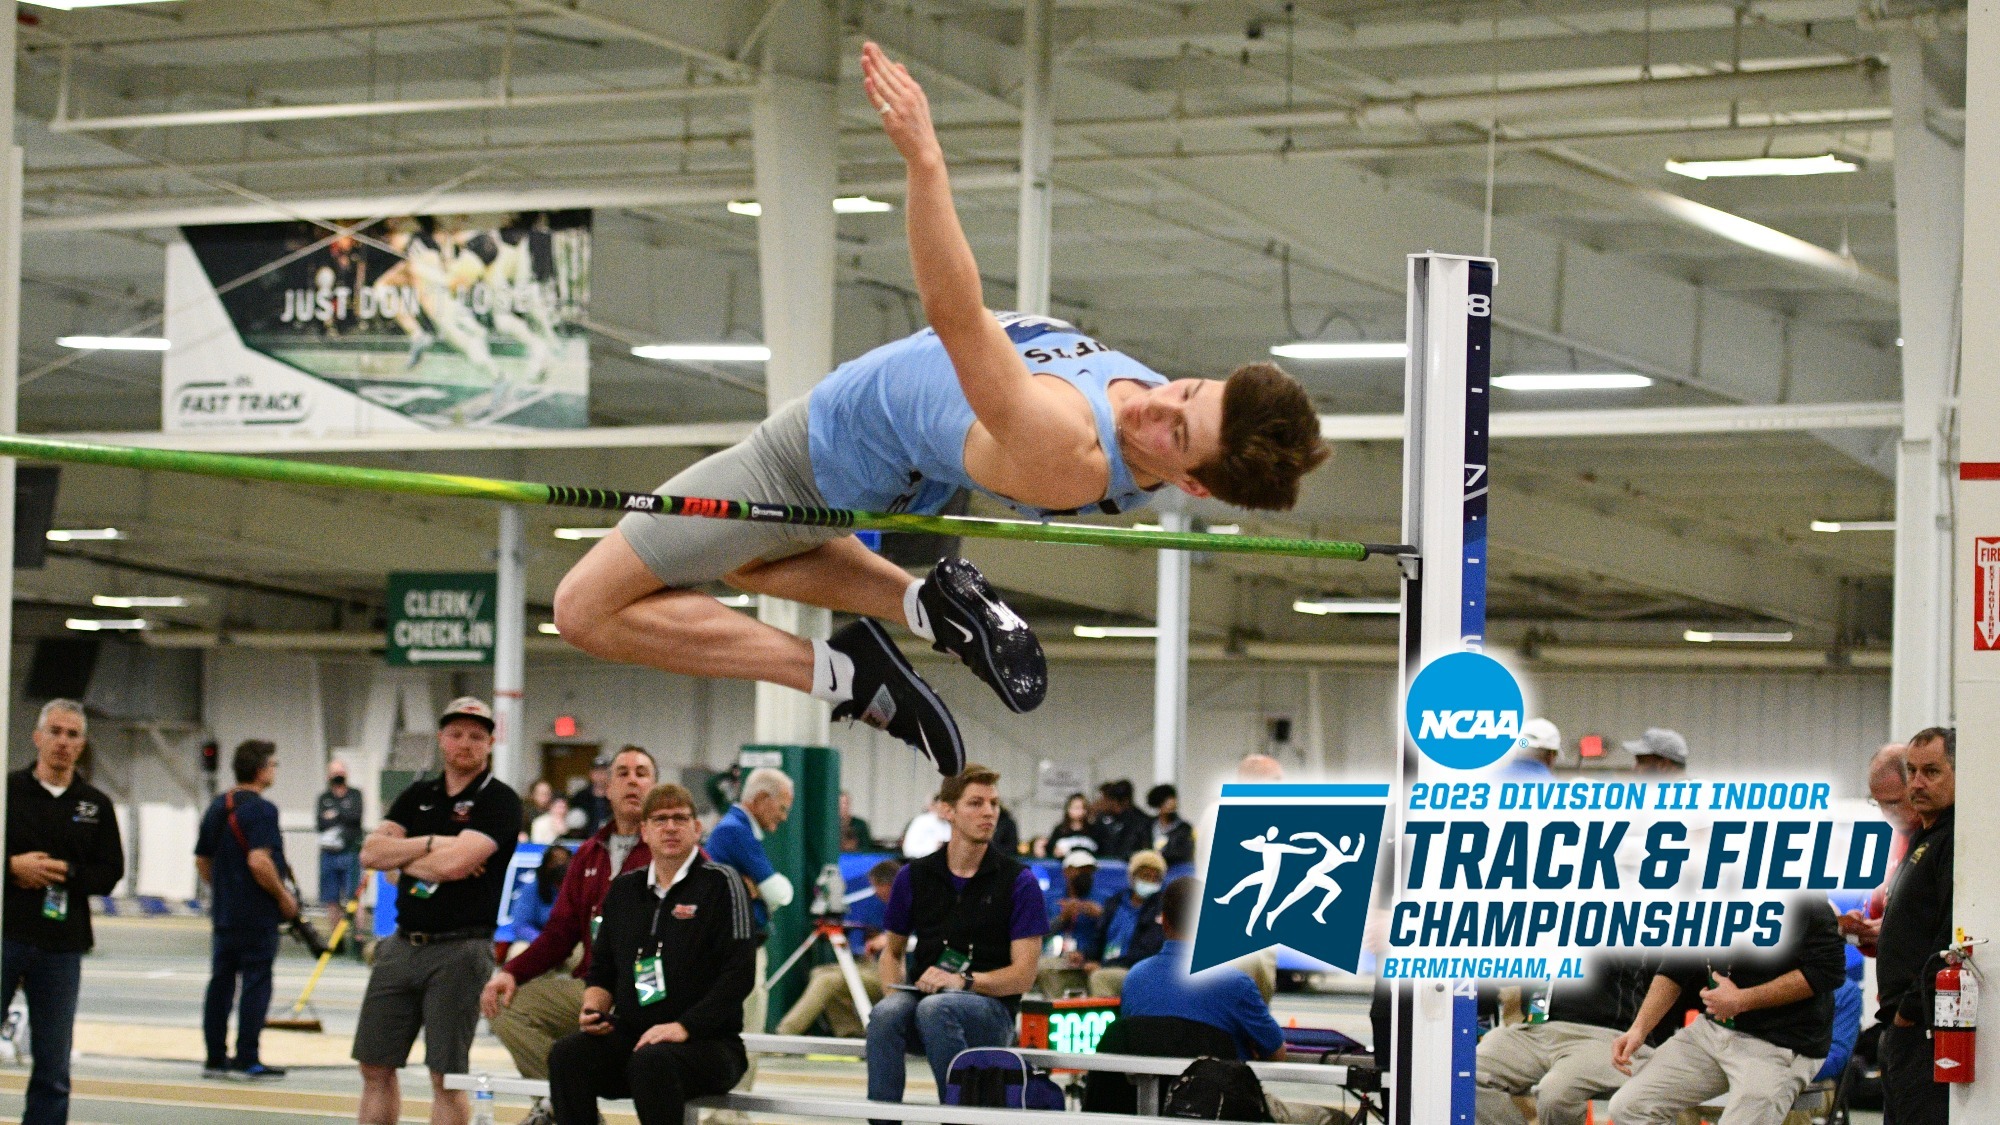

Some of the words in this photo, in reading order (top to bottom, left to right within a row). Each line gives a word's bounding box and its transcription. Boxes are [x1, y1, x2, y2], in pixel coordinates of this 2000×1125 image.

[281, 286, 352, 322] JUST
[360, 285, 446, 320] DON
[1467, 294, 1491, 317] 8
[1024, 341, 1107, 363] FTS
[180, 394, 231, 413] FAST
[239, 392, 303, 411] TRACK
[1464, 464, 1487, 487] 7
[625, 495, 655, 510] AGX
[404, 590, 486, 620] CLERK/
[394, 620, 493, 648] CHECK-IN
[1454, 978, 1477, 1000] 4
